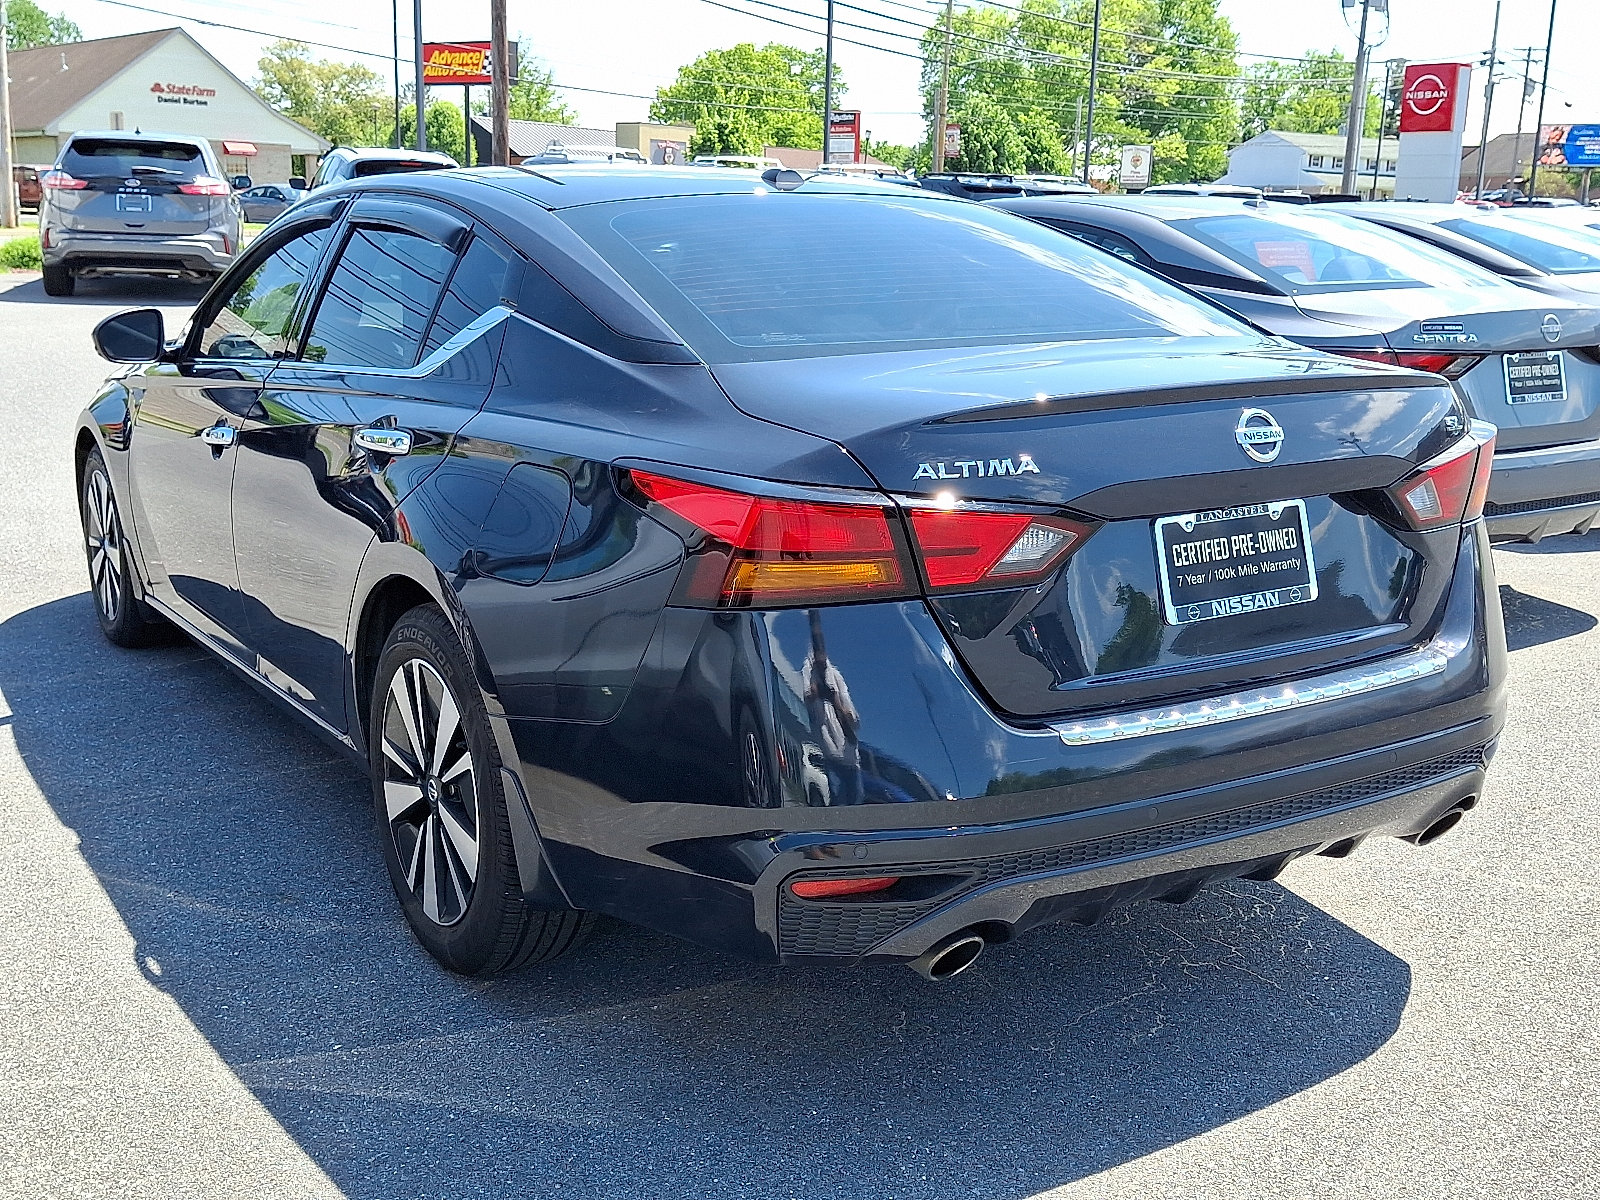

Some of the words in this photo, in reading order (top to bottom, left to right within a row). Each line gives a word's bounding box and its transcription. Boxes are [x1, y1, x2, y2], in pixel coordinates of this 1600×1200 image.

[430, 50, 480, 65] Advance
[157, 95, 181, 103] Daniel
[183, 97, 208, 106] Burton
[1406, 90, 1448, 99] NISSAN
[1413, 333, 1479, 344] SENTRA
[1509, 365, 1532, 379] CERTIFIED
[1531, 363, 1560, 377] PRE-OWNED
[1525, 393, 1551, 402] NISSAN
[1243, 430, 1282, 441] NISSAN
[912, 456, 1041, 480] ALTIMA
[1200, 505, 1265, 521] LANCASTER
[1172, 537, 1230, 567] CERTIFIED
[1230, 527, 1298, 558] PRE-OWNED
[1177, 575, 1184, 587] 7
[1185, 573, 1206, 586] Year
[1214, 566, 1237, 581] 100k
[1238, 563, 1260, 577] Mile
[1260, 557, 1301, 573] Warranty
[1211, 591, 1280, 616] NISSAN
[397, 627, 454, 679] ENDEAVOR
